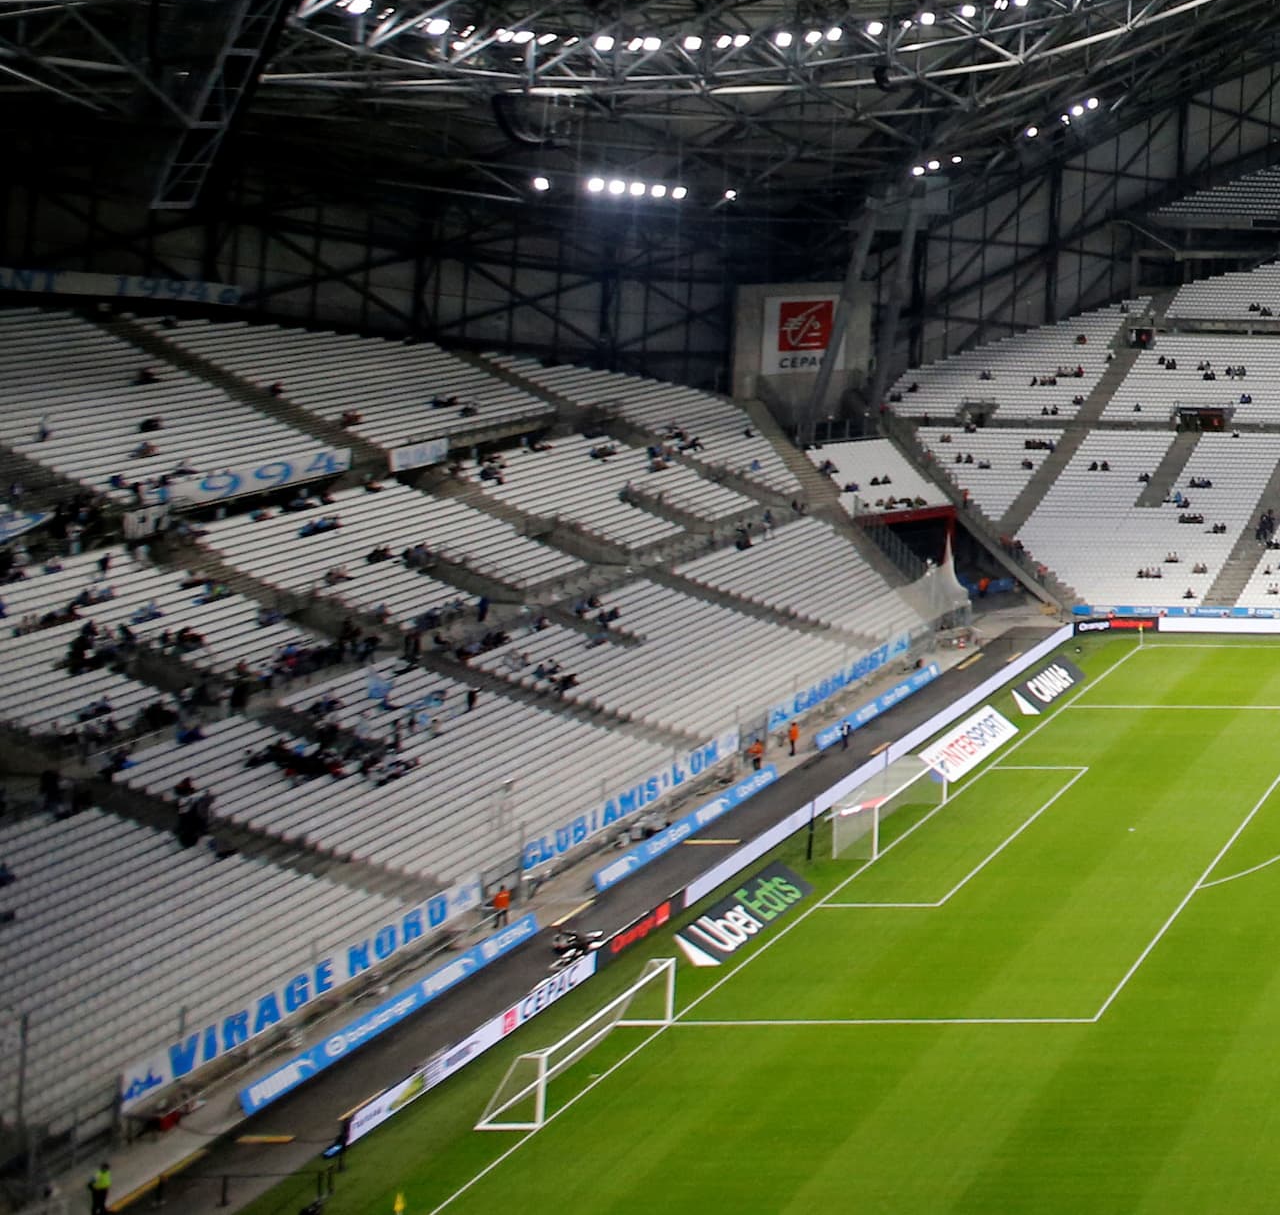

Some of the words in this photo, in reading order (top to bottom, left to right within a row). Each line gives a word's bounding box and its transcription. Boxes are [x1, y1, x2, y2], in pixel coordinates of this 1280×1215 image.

[1079, 619, 1109, 631] Orange
[1026, 663, 1076, 703] CANAL+
[943, 714, 1007, 768] INTERSPORT
[522, 815, 589, 870] CLUB
[602, 776, 661, 828] AMIS
[688, 904, 765, 953] Uber
[734, 876, 802, 922] Eats
[168, 957, 335, 1079] VIRAGE
[346, 893, 449, 980] NORD
[520, 964, 579, 1020] CEPAC
